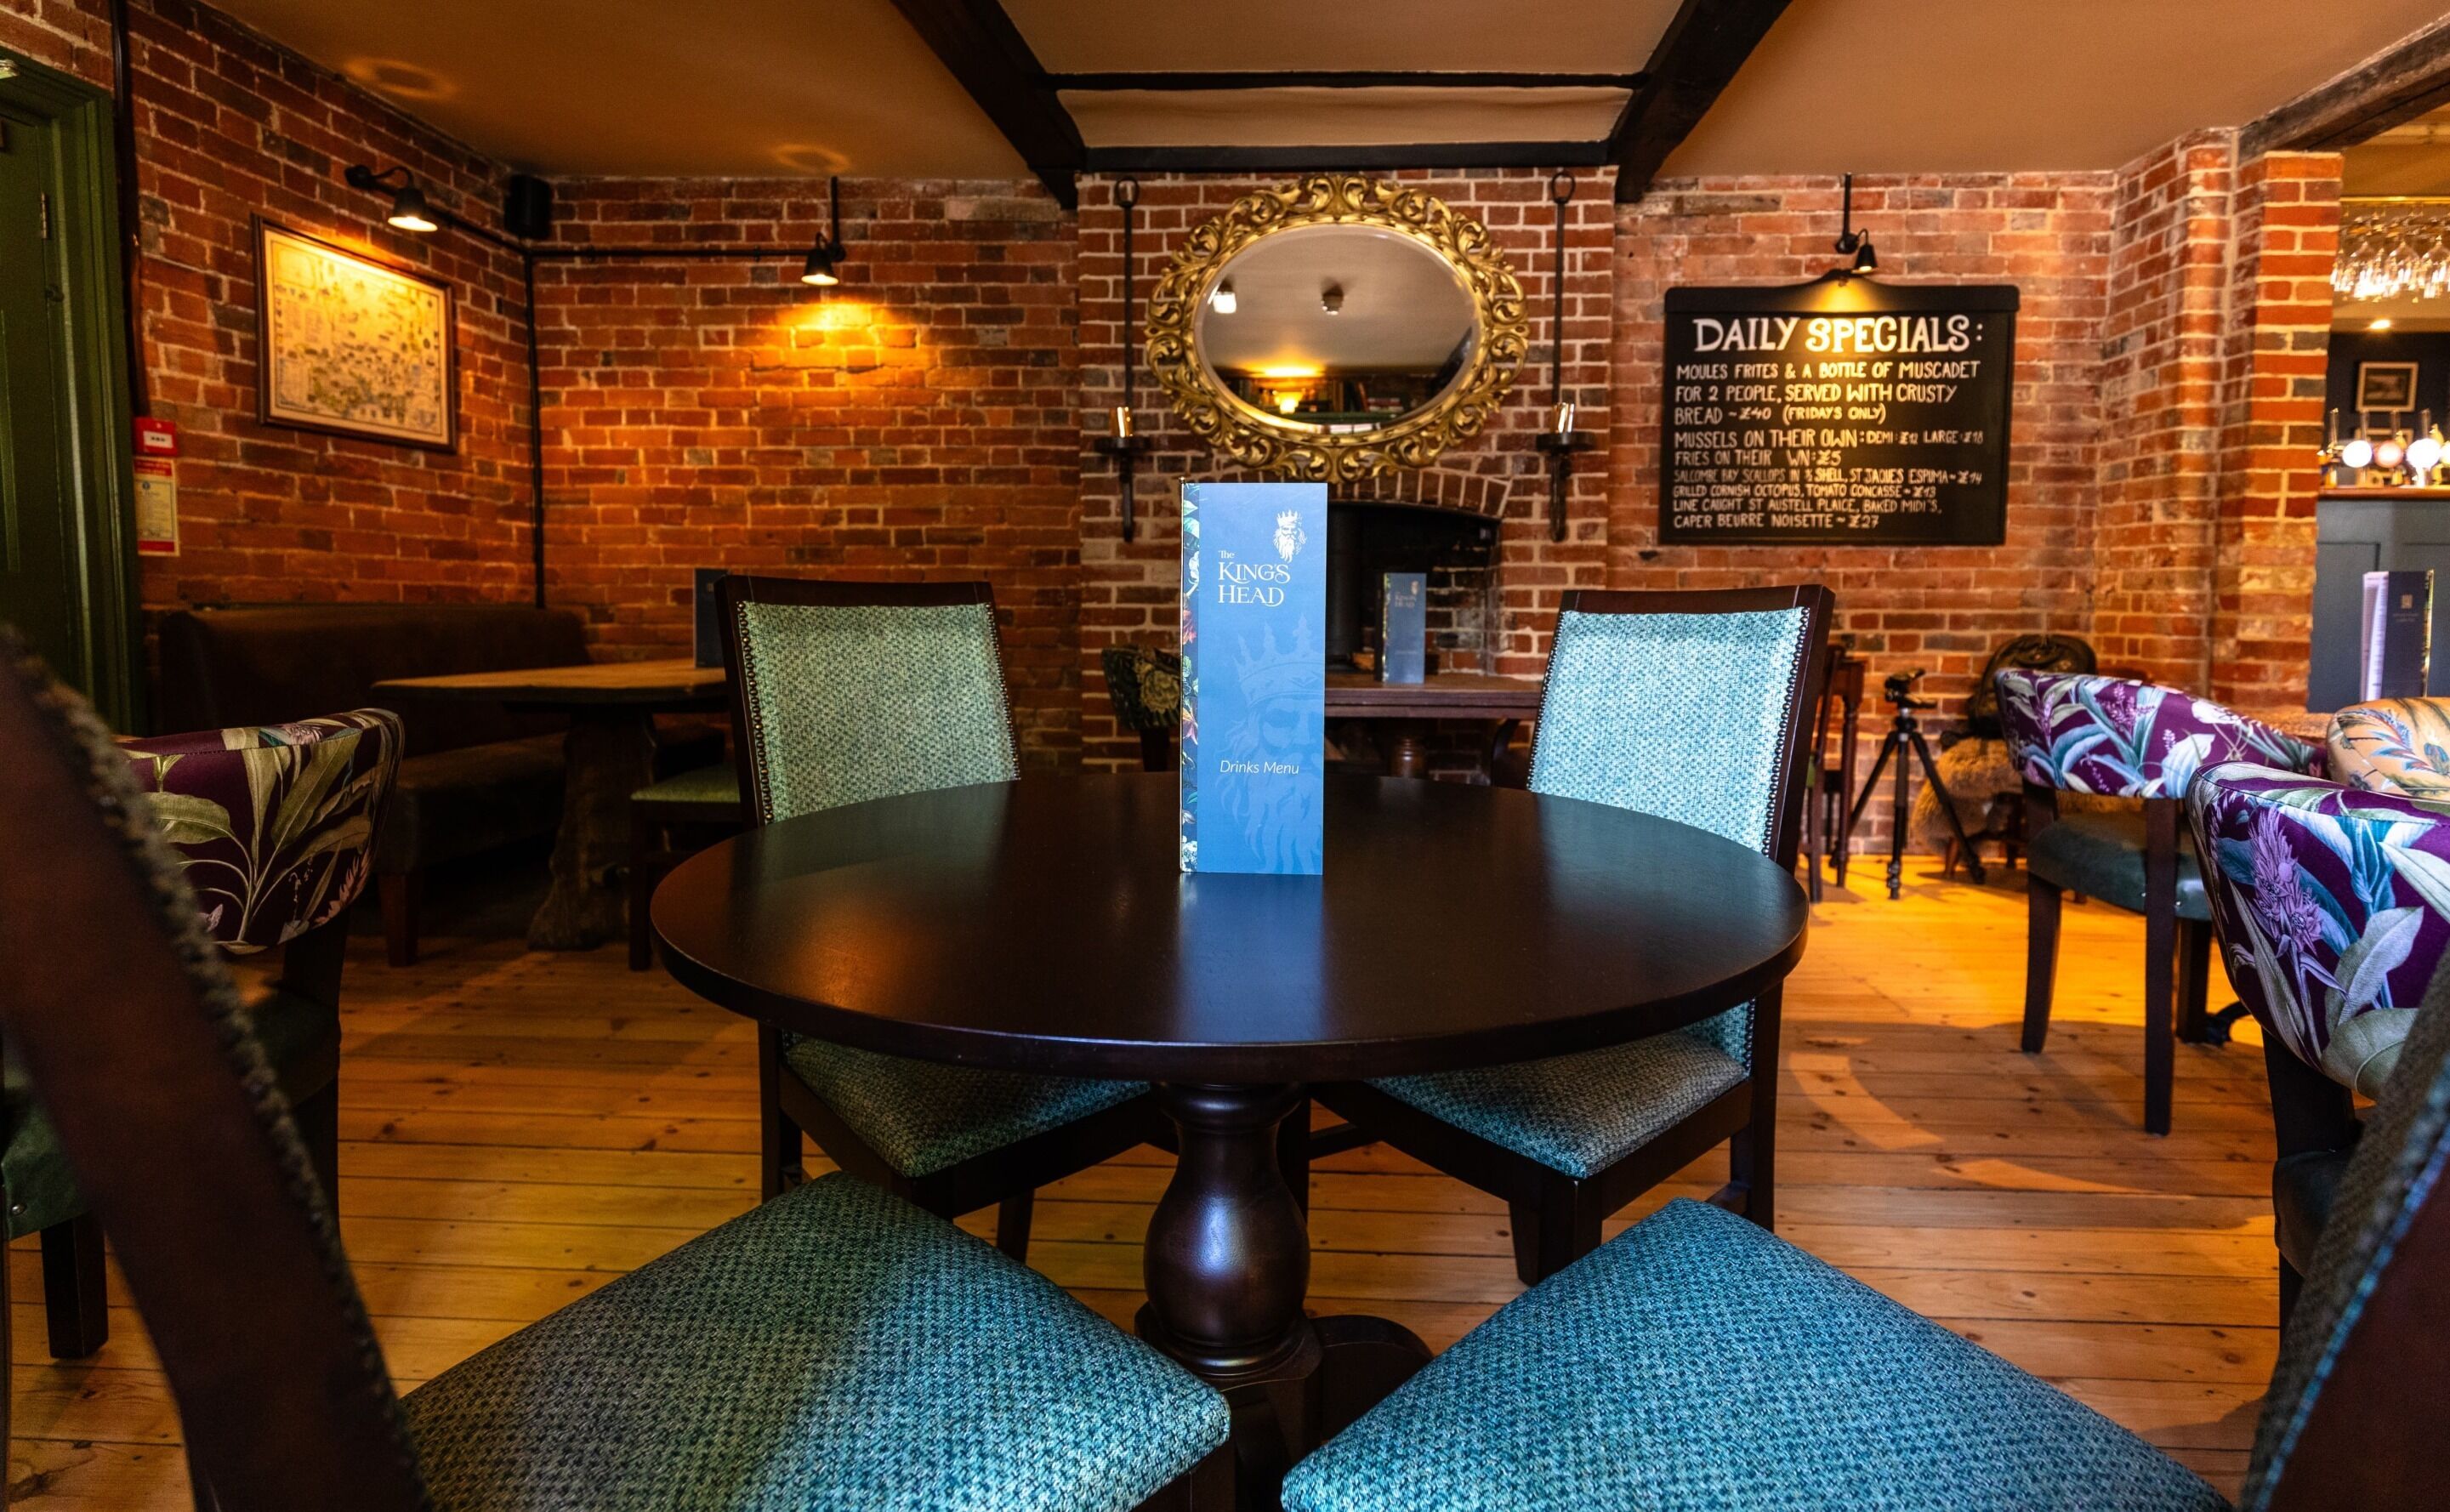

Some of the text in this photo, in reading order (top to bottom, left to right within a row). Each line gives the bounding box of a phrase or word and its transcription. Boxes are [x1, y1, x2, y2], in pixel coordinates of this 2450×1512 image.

[1692, 315, 1984, 353] DAILY SPECIALS:
[1676, 361, 1981, 380] MOULES FRITES & A BOTTLE OF MUSCADET
[1675, 384, 1958, 404] FOR 2 PEOPLE, SERVED WITH CRUSTY
[1674, 406, 1723, 425] BREAD
[1782, 404, 1843, 425] (FRIDAYS
[1847, 403, 1886, 425] ONLY)
[1674, 431, 1737, 448] MUSSELS
[1743, 429, 1765, 448] ON
[1769, 429, 1816, 448] THEIR
[1674, 451, 1710, 466] FRIES
[1714, 451, 1731, 465] ON
[1734, 449, 1772, 465] THEIR
[1674, 469, 1718, 483] SALCOMBE
[1721, 469, 1739, 482] BAY
[1742, 469, 1786, 483] SCALLOPS
[1790, 469, 1800, 482] IN
[1814, 467, 1848, 483] SHELL,
[1850, 468, 1862, 483] ST
[1908, 469, 1948, 484] ESPUMA
[1673, 485, 1708, 497] GRILLED
[1709, 484, 1751, 497] CORNISH
[1754, 484, 1805, 497] OCTOPUS,
[1807, 483, 1847, 497] TOMATO
[1850, 485, 1902, 498] CONCASSE
[1673, 499, 1698, 512] LINE
[1702, 498, 1744, 512] CAUGHT
[1748, 498, 1764, 511] ST
[1767, 498, 1813, 512] AUSTELL
[1862, 499, 1897, 513] BAKED
[1674, 515, 1713, 529] CAPER
[1717, 514, 1765, 527] BEURRE
[1771, 514, 1834, 528] NOISETTE
[1218, 549, 1235, 559] The
[1218, 584, 1285, 607] HEAD
[1219, 759, 1299, 775] Drinks Menu
